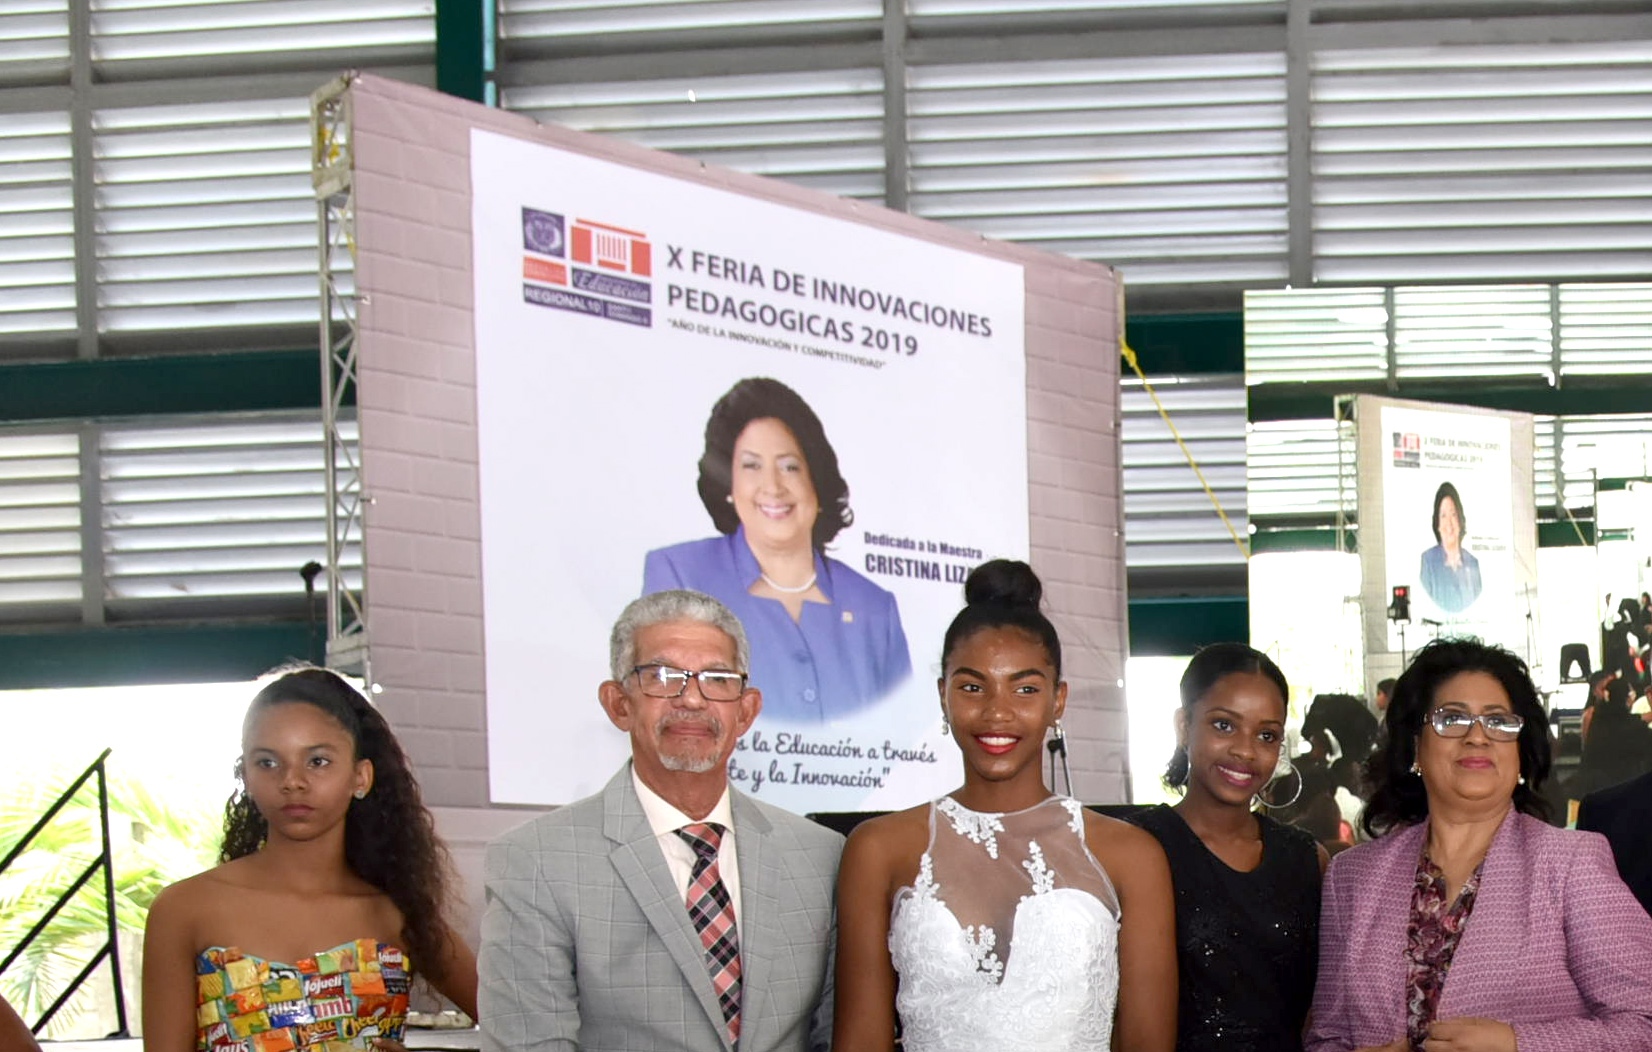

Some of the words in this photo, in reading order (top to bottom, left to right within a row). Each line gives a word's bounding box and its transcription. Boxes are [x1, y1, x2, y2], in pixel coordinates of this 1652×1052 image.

[667, 245, 683, 270] X
[692, 250, 765, 288] FERIA
[772, 269, 806, 297] DE
[813, 277, 992, 338] INNOVACIONES
[667, 284, 854, 343] PEDAGOGICAS
[860, 326, 919, 357] 2019
[697, 325, 711, 337] DE
[713, 326, 726, 338] LA
[864, 531, 916, 550] Dedicada
[918, 541, 925, 551] a
[927, 540, 937, 553] la
[939, 542, 982, 560] Maestra
[865, 553, 941, 582] CRISTINA
[752, 730, 771, 753] la
[775, 732, 864, 759] Educación
[867, 746, 879, 760] a
[881, 740, 938, 764] través
[751, 768, 765, 793] y
[768, 759, 788, 784] la
[791, 762, 890, 789] Innovación"
